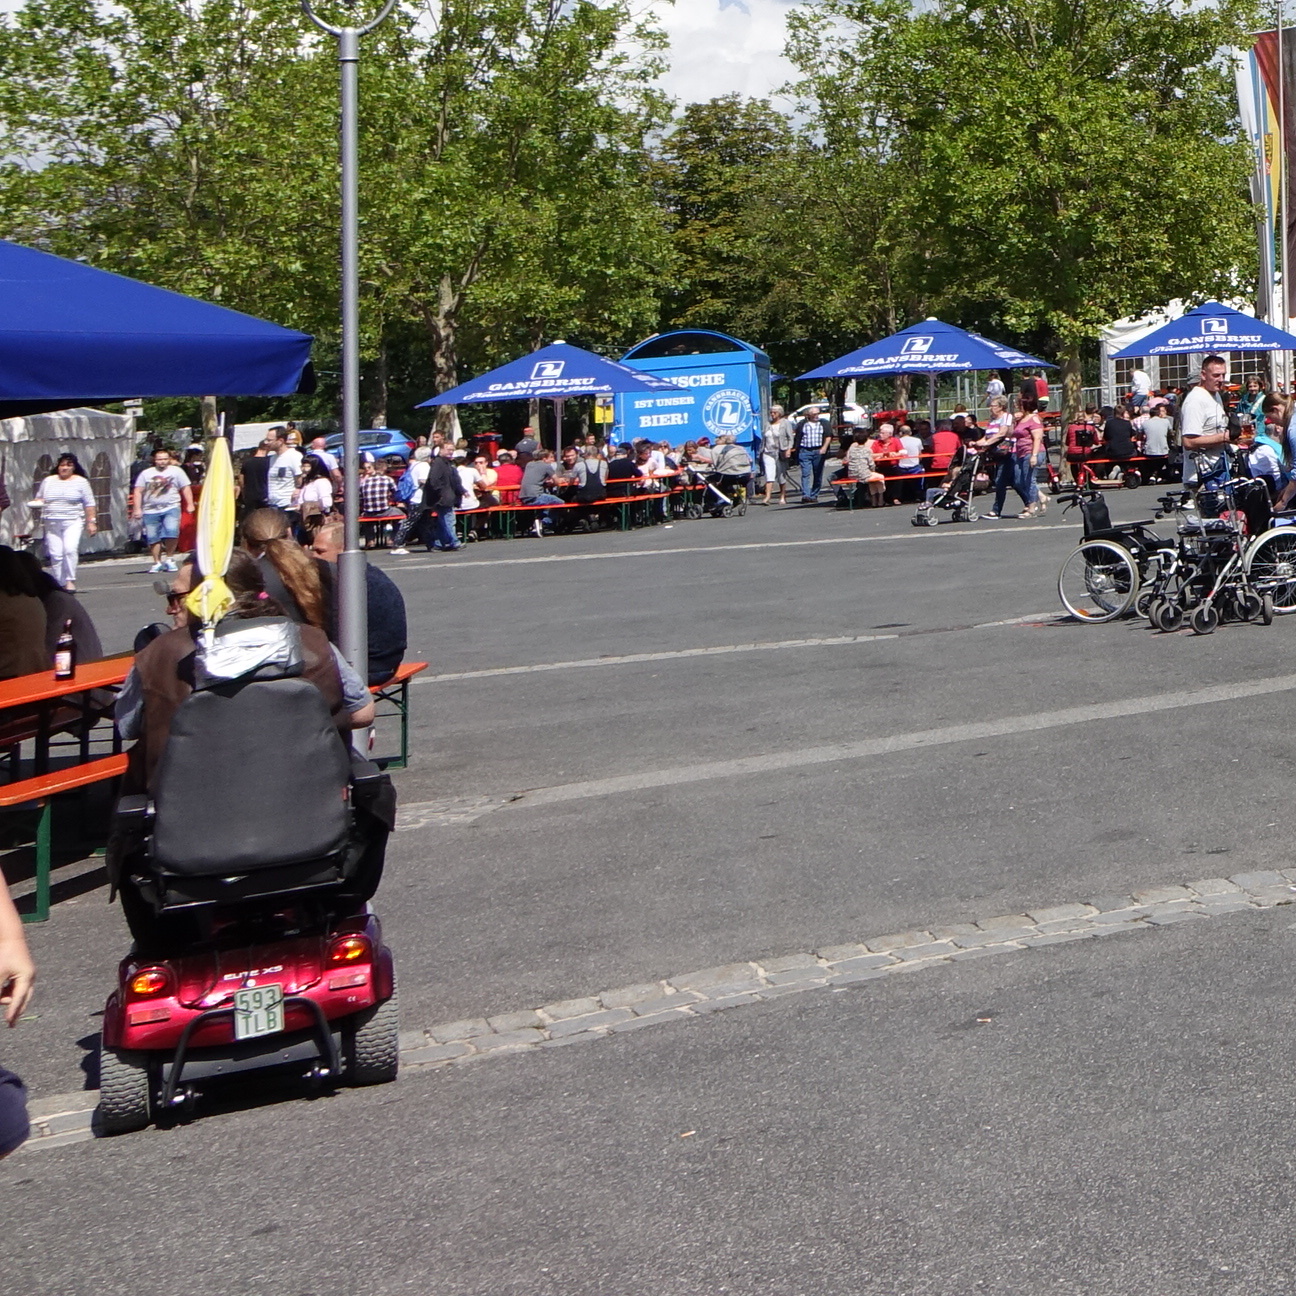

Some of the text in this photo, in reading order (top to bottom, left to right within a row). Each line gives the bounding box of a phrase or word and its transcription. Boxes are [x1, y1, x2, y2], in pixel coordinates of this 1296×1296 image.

[1167, 334, 1263, 346] GANSBRÄU
[861, 353, 960, 367] GANSBRÄU
[487, 377, 598, 392] GANSBRÄU
[633, 396, 695, 409] IST UNSER
[639, 412, 689, 428] BIER!
[239, 988, 277, 1012] 593
[241, 1009, 278, 1036] TLB
